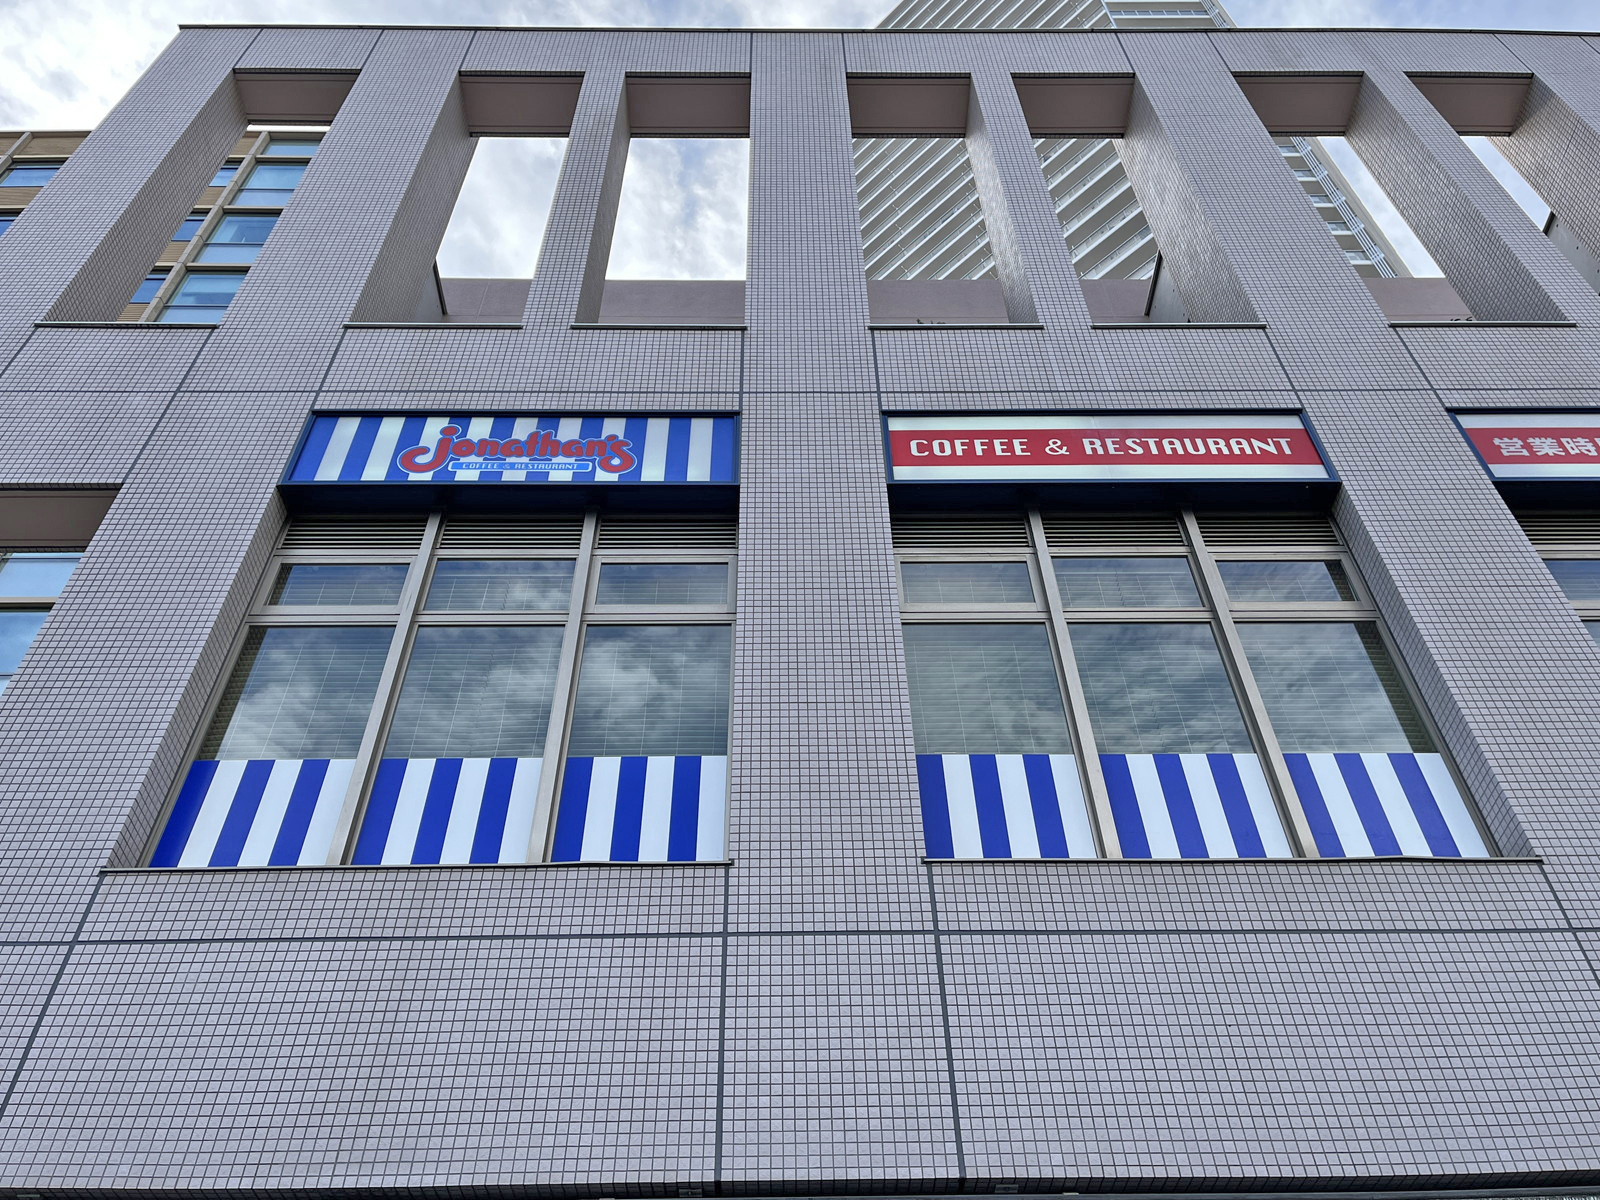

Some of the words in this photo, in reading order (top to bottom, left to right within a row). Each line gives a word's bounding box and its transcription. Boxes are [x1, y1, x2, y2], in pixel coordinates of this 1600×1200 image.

[910, 438, 1031, 457] COFFEE
[1044, 438, 1070, 456] &
[1081, 437, 1293, 456] RESTAURANT
[1492, 437, 1600, 456] 営業時
[462, 462, 500, 470] COFFEE
[514, 462, 578, 470] RESTAURANT
